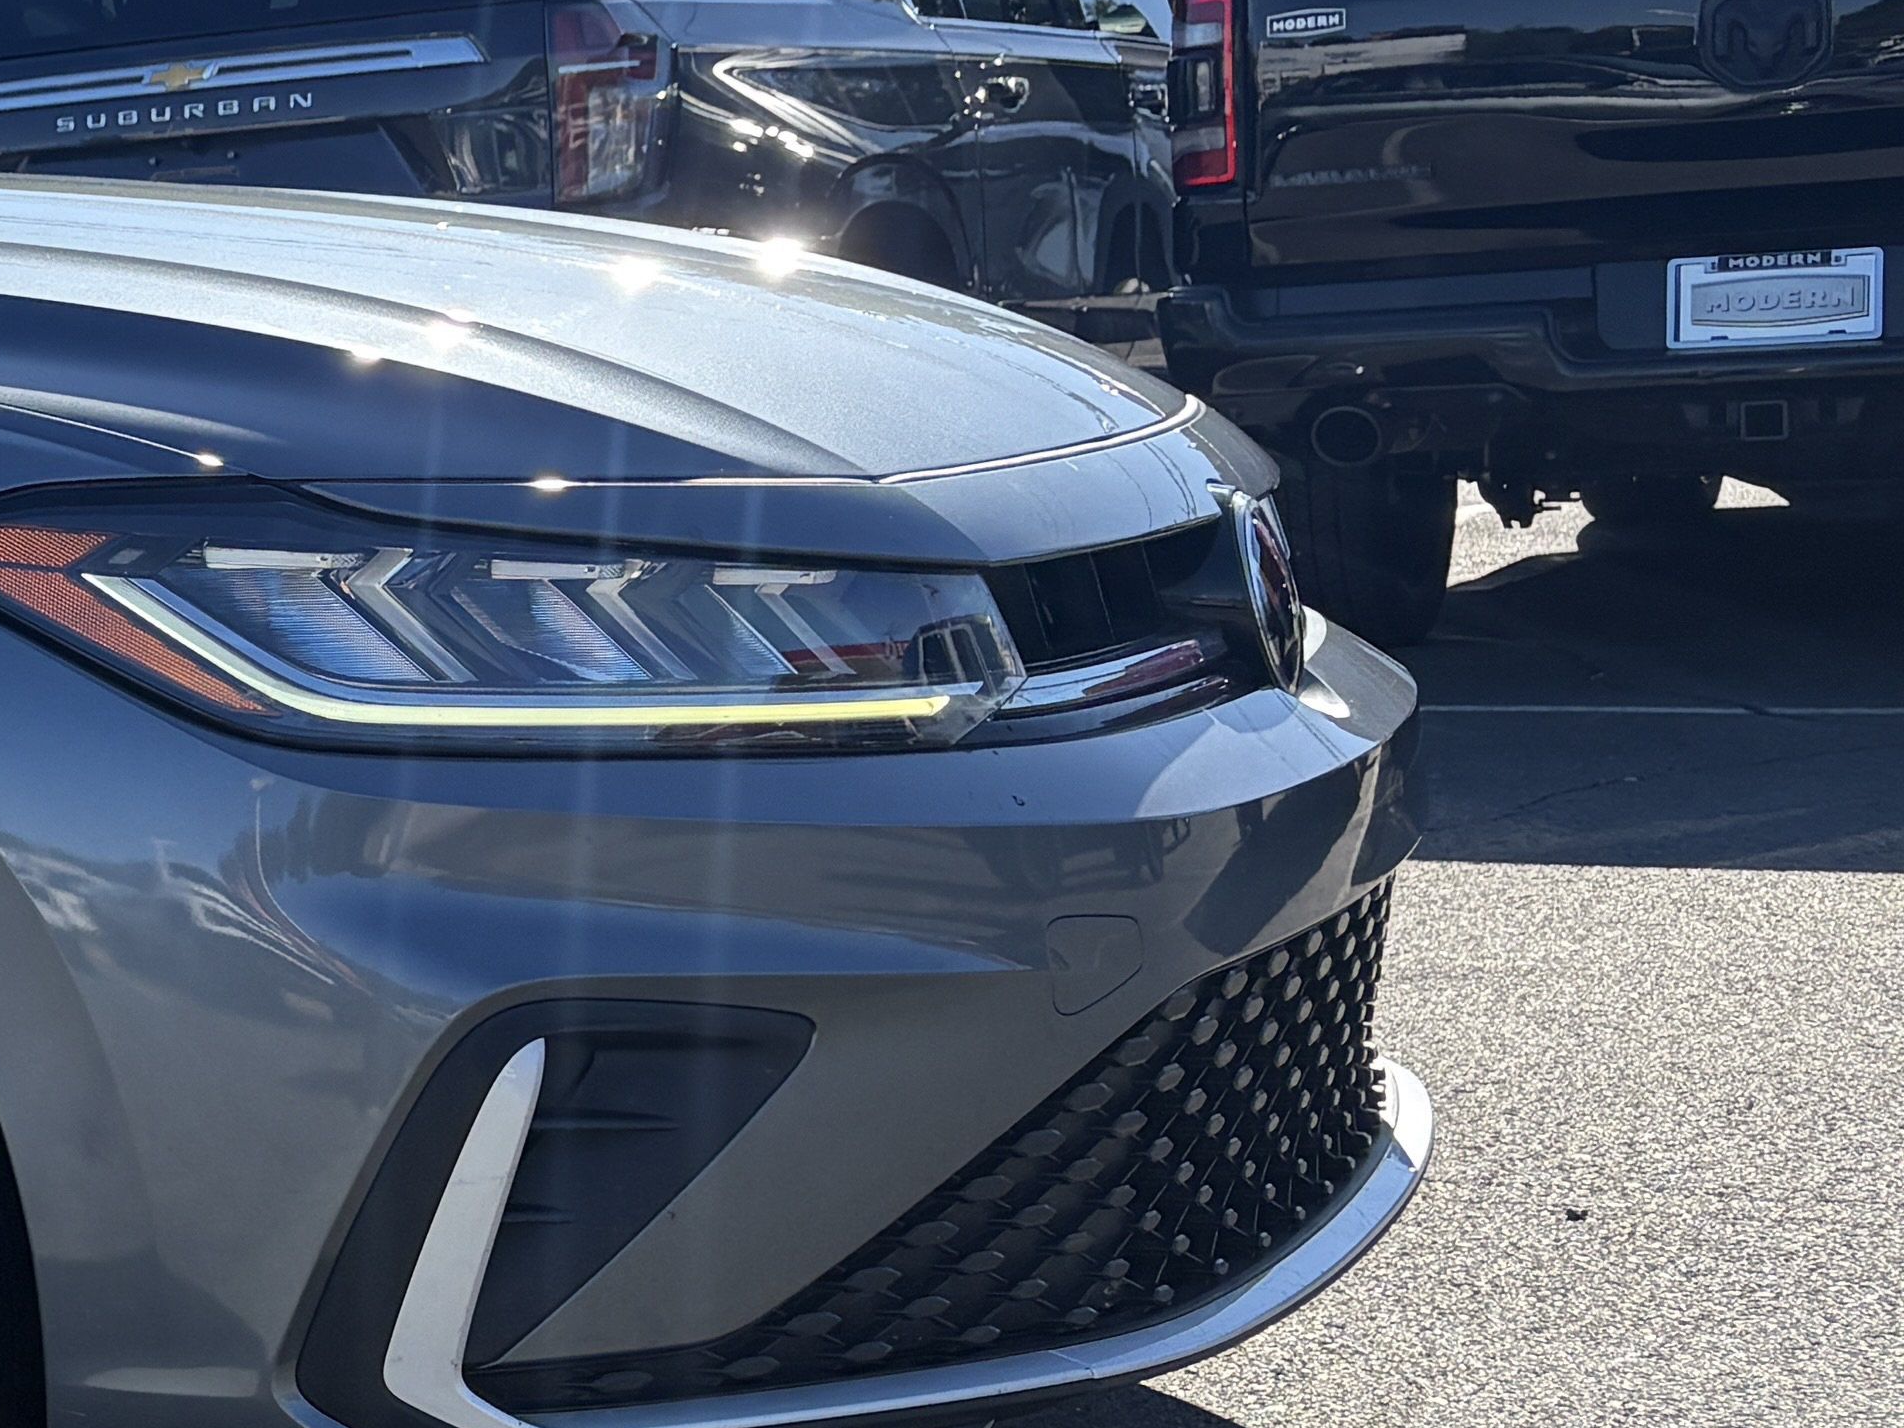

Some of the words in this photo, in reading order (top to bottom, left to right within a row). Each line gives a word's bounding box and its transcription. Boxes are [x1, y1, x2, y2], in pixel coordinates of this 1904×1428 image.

[1272, 13, 1340, 33] MODERN
[56, 92, 313, 133] SUBURBAN
[1728, 251, 1823, 270] MODERN
[1705, 285, 1856, 315] MODERN
